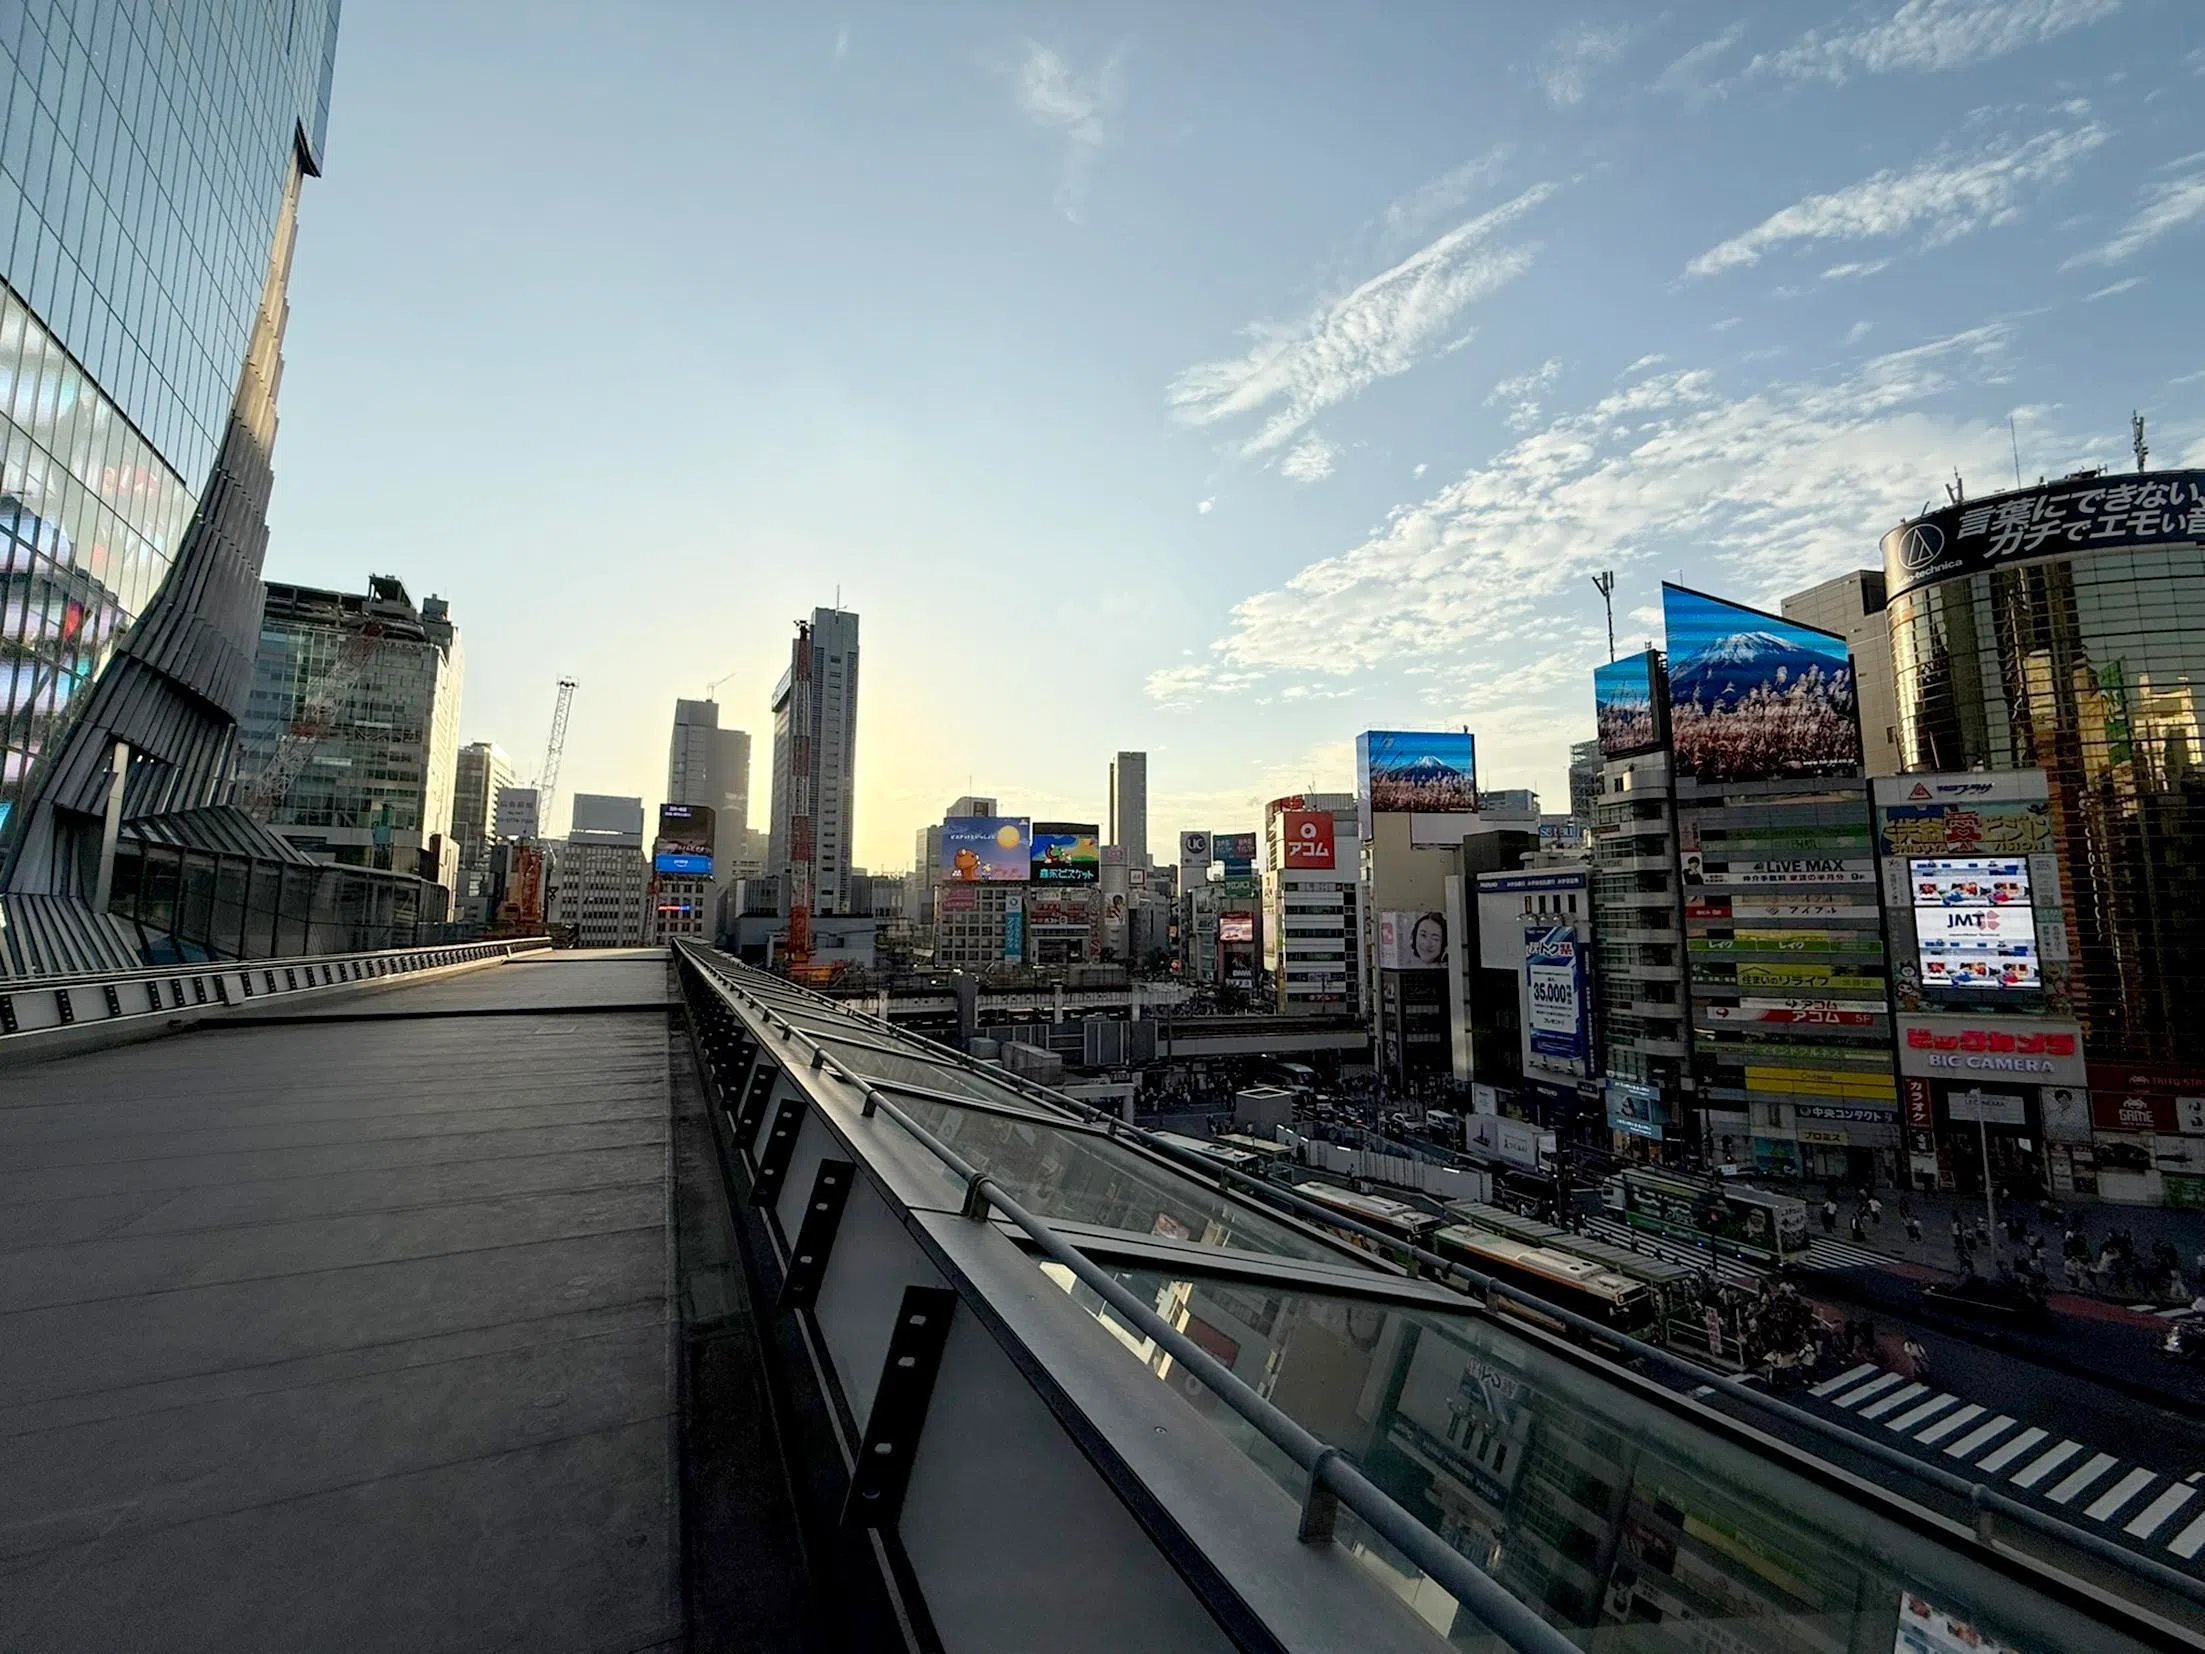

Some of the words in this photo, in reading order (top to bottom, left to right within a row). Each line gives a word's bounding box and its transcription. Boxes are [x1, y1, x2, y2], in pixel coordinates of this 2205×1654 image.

[1288, 842, 1329, 856] アコム
[1806, 859, 1845, 872] MAX
[1947, 914, 1984, 928] JMT
[1792, 1011, 1840, 1022] アコム
[1929, 1055, 1961, 1067] BIC
[1967, 1056, 2054, 1073] CAMERA
[1812, 1107, 1881, 1121] 中央コンタクト
